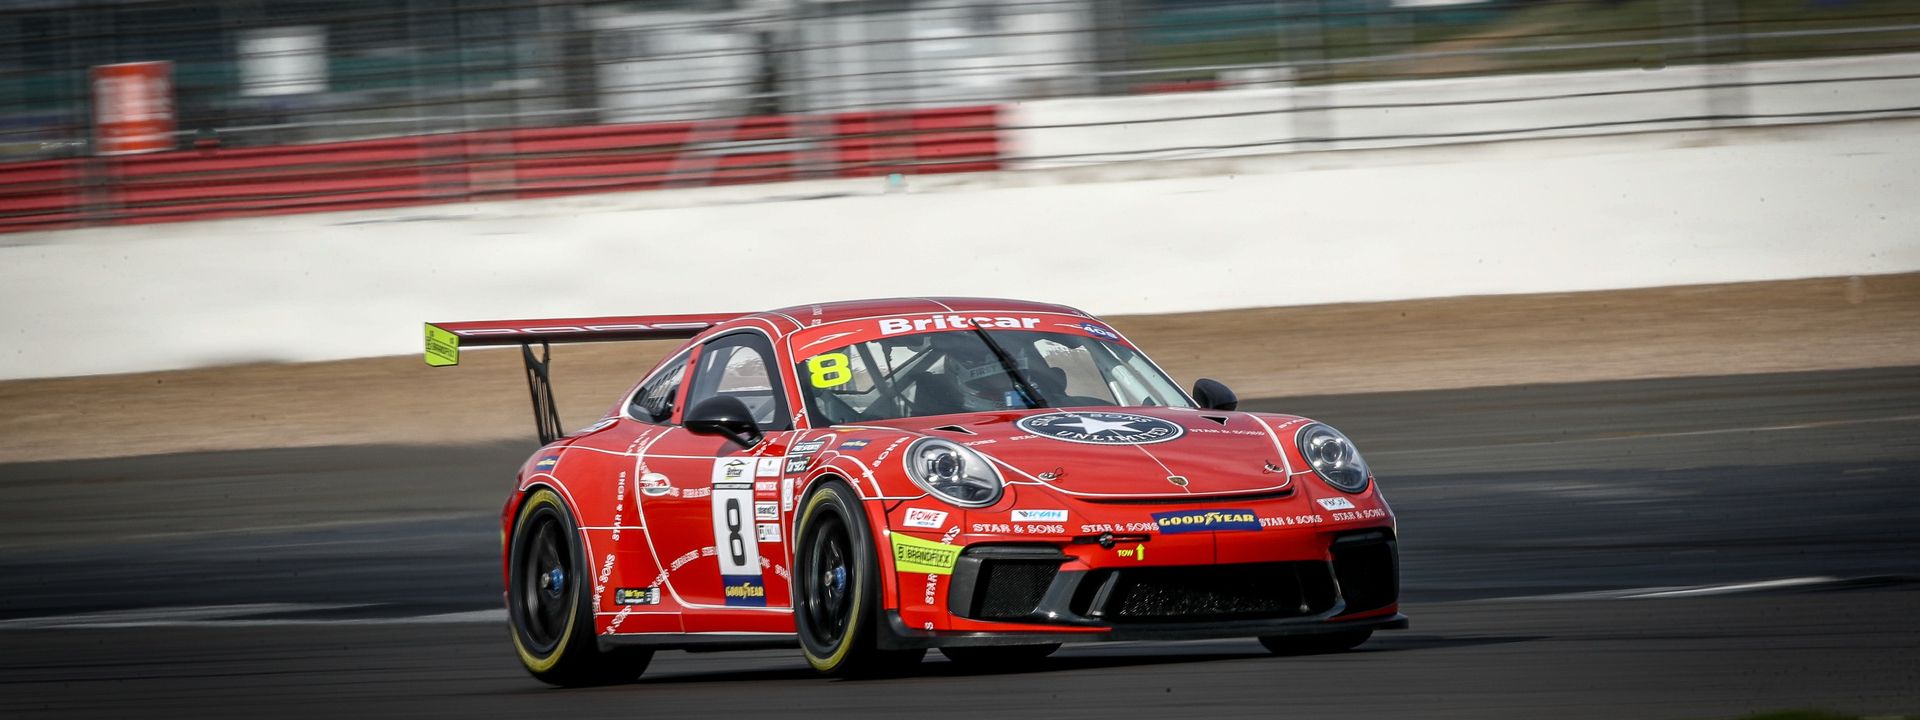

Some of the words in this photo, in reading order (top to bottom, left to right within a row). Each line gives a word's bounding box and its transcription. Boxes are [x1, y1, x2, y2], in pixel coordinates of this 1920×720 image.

[878, 314, 1041, 336] Britcar
[807, 353, 851, 388] 8
[1056, 427, 1169, 443] UNLIMITED
[910, 510, 940, 522] ROWE
[1158, 512, 1255, 526] GOODYEAR
[1332, 513, 1354, 521] STAR
[1355, 511, 1363, 519] &
[1363, 508, 1386, 519] SONS
[1079, 523, 1112, 533] STAR
[1114, 523, 1125, 533] &
[1125, 521, 1160, 532] SONS
[1258, 517, 1287, 528] STAR
[1288, 516, 1295, 525] &
[1295, 515, 1323, 525] SONS
[726, 498, 746, 566] 8
[971, 523, 1011, 534] STAR
[1013, 524, 1024, 534] &
[1027, 524, 1065, 534] SONS
[1117, 549, 1134, 557] TOW
[599, 553, 616, 583] SONS
[725, 586, 764, 597] GOODYEAR
[923, 572, 939, 606] STAR
